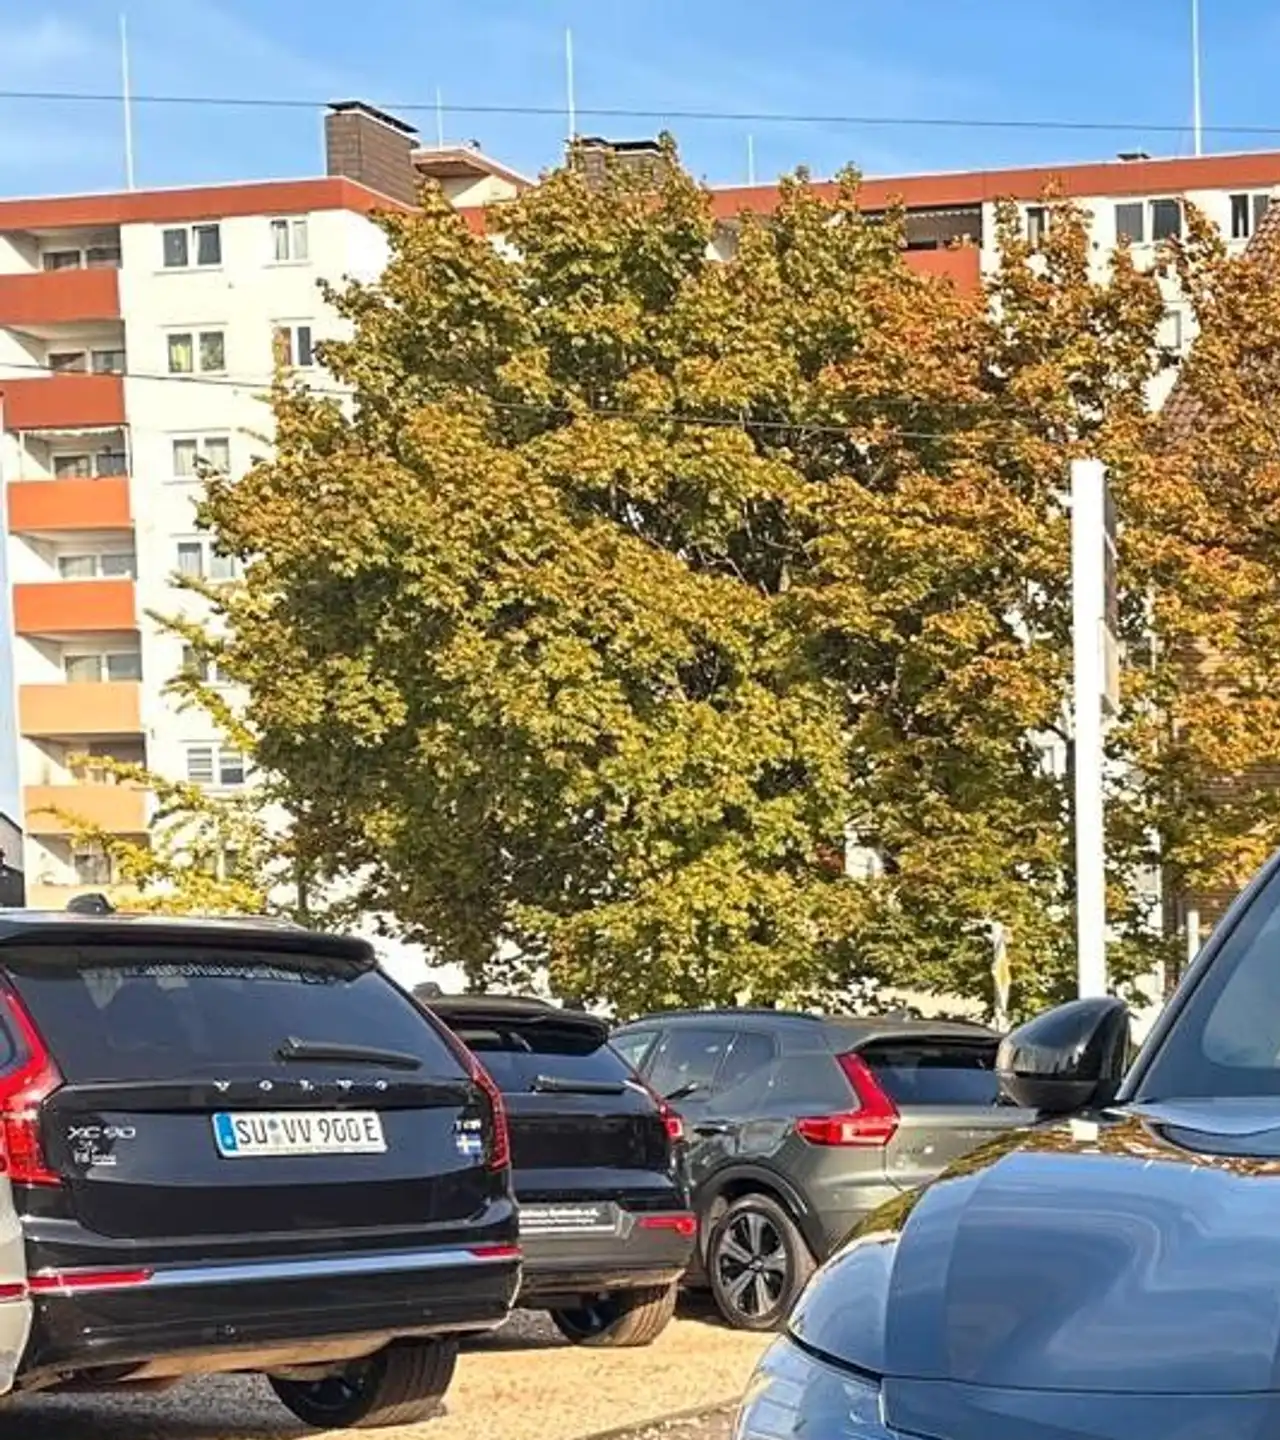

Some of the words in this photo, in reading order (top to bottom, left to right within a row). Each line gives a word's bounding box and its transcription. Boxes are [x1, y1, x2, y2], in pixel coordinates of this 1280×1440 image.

[213, 1078, 389, 1093] VOLVO
[236, 1119, 267, 1144] SU
[281, 1118, 311, 1143] VV
